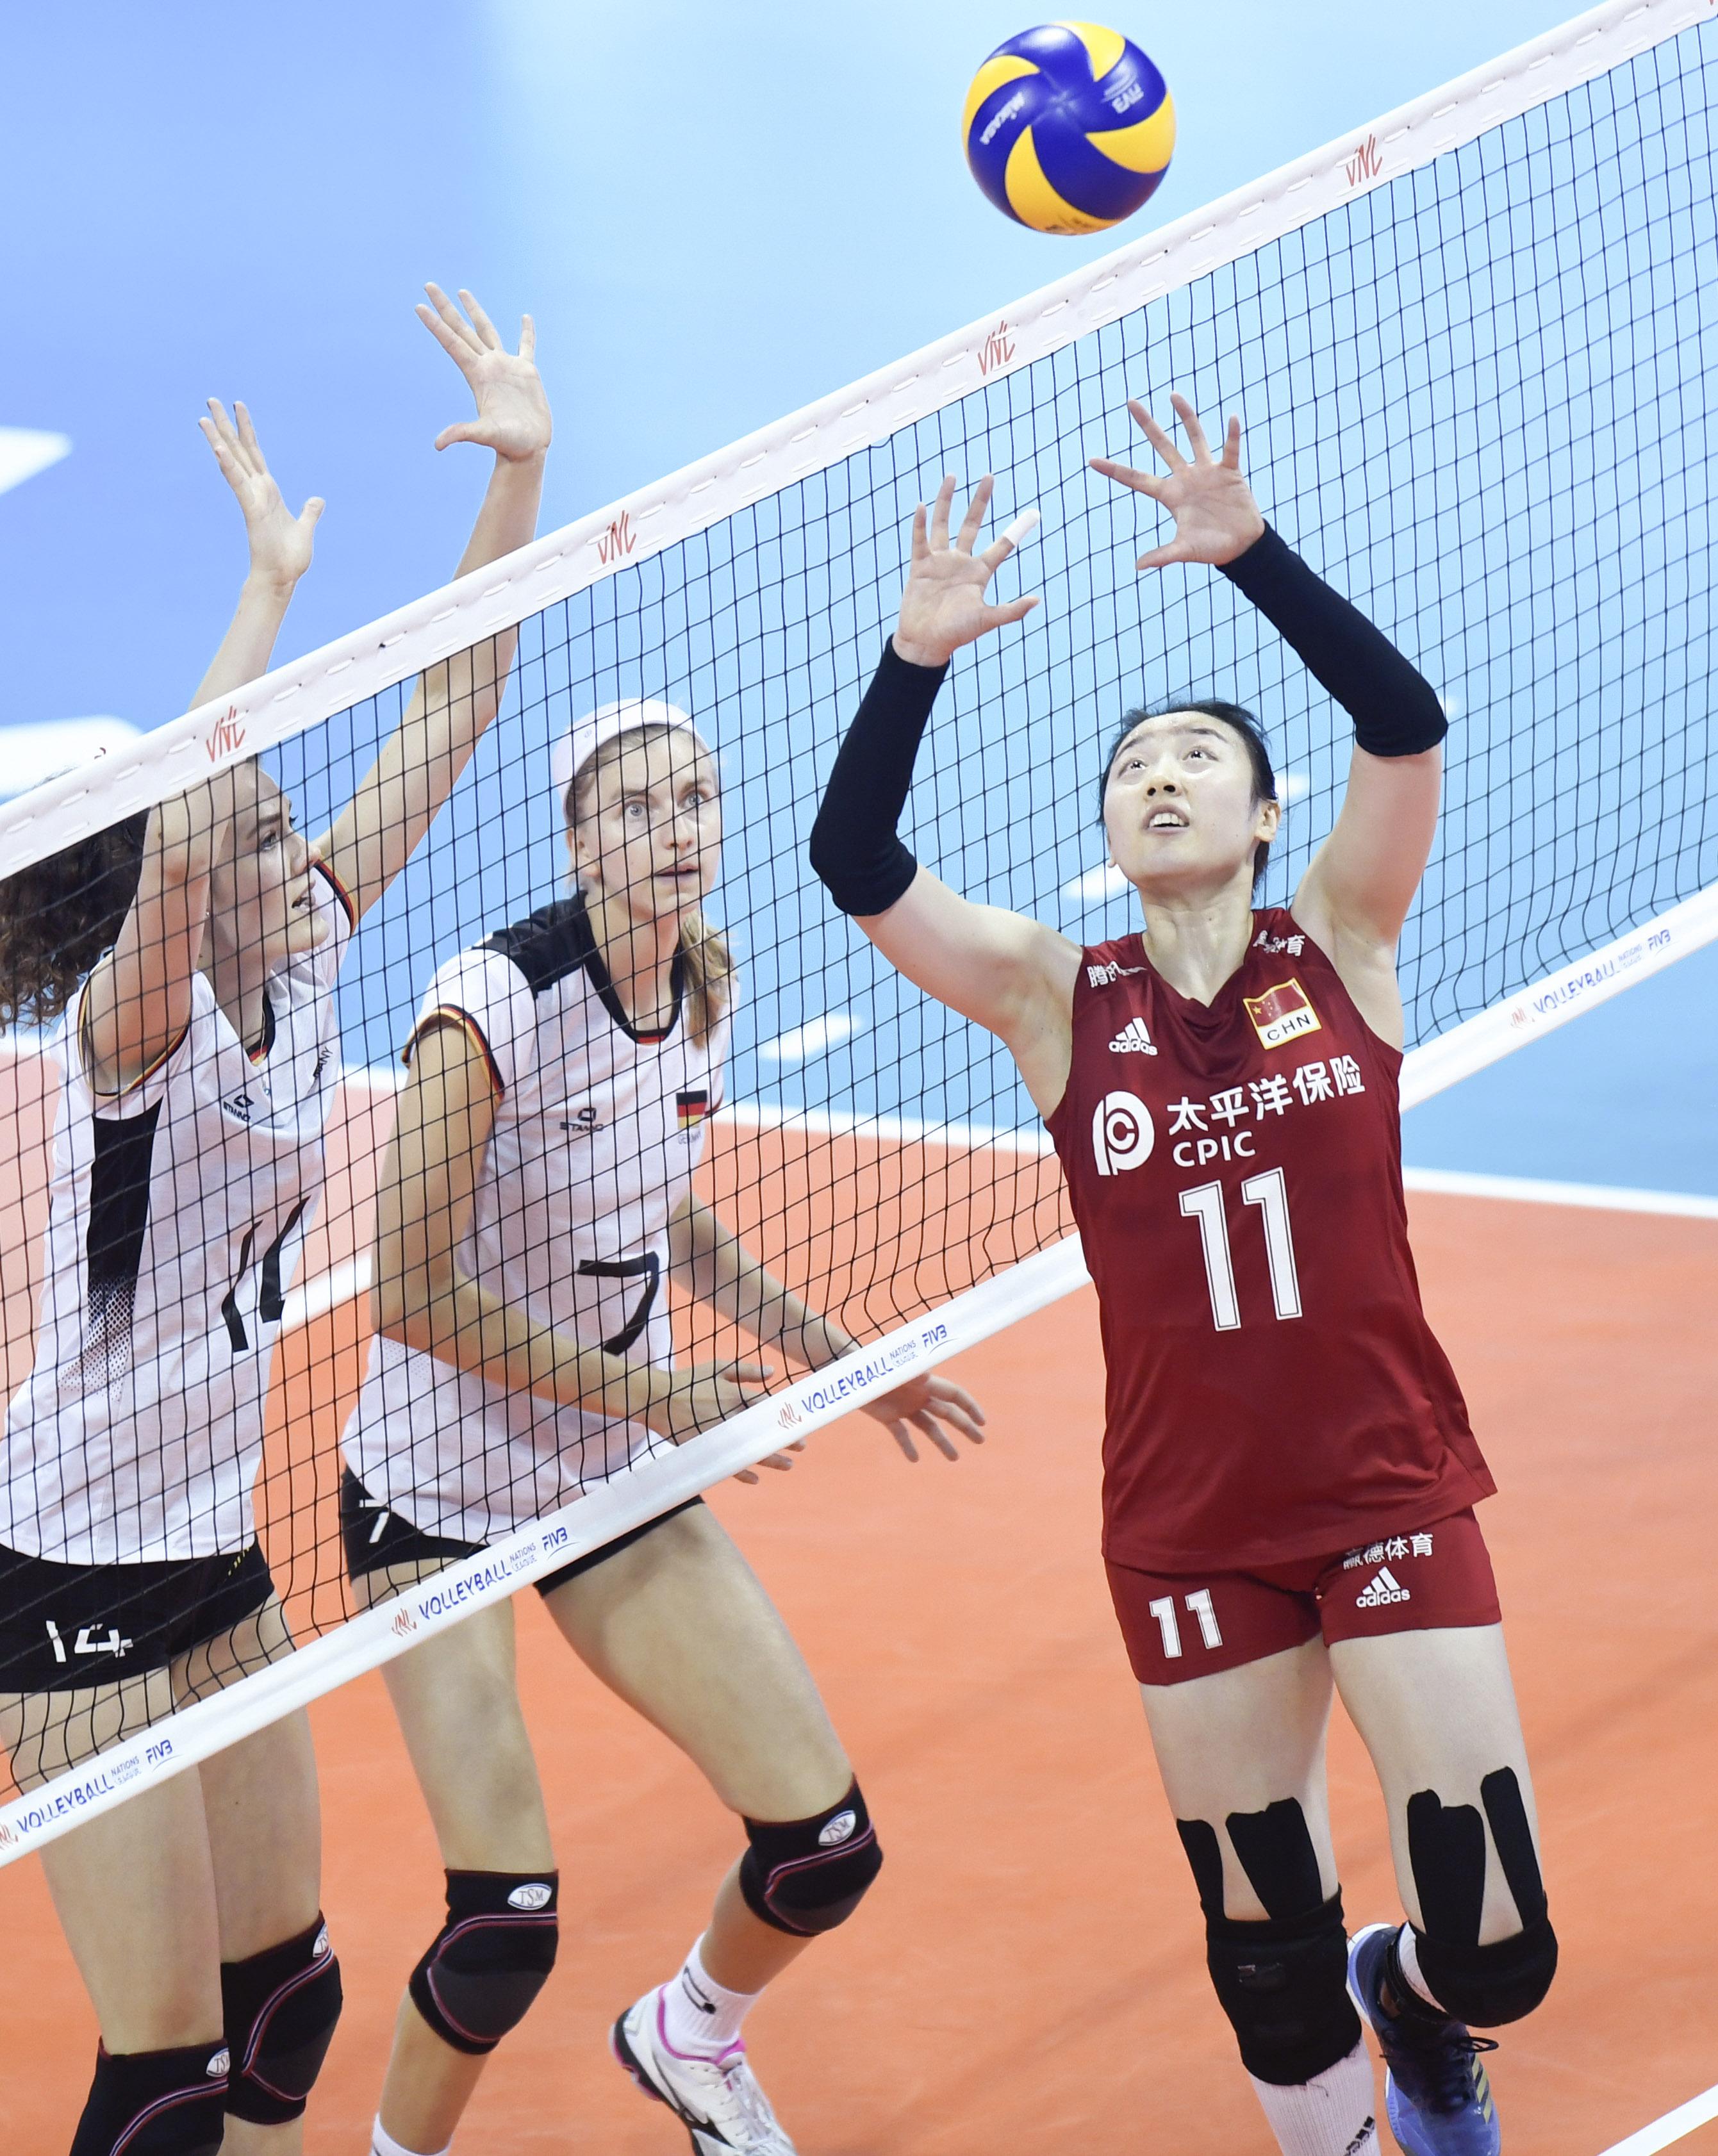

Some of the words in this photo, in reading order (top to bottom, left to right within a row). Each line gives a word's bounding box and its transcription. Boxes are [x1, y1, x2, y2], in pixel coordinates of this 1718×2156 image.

[1346, 133, 1382, 186] VNL
[978, 320, 1015, 375] VNL
[597, 510, 636, 564] VNL
[206, 705, 245, 762] VNL
[1648, 929, 1671, 951] FIVB
[1533, 960, 1621, 1013] VOLLEYBALL
[1109, 1039, 1158, 1056] adidas
[1267, 1014, 1311, 1041] CHN
[1167, 1055, 1366, 1136] 太平洋保险
[1173, 1131, 1256, 1167] CPIC
[1178, 1167, 1303, 1332] 11
[577, 1250, 659, 1356] 7
[889, 1340, 916, 1360] NATIONS
[921, 1324, 947, 1348] FIVB
[802, 1357, 894, 1413] VOLLEYBALL
[509, 1542, 536, 1563] NATIONS
[542, 1527, 568, 1551] FIVB
[418, 1559, 512, 1620] VOLLEYBALL
[1356, 1589, 1410, 1608] adidas
[45, 1620, 133, 1663] 14
[1149, 1588, 1223, 1658] 11
[111, 1756, 139, 1776] NATIONS
[145, 1739, 172, 1764] FIVB
[17, 1774, 115, 1832] VOLLEYBALL
[518, 1889, 543, 1906] TSM
